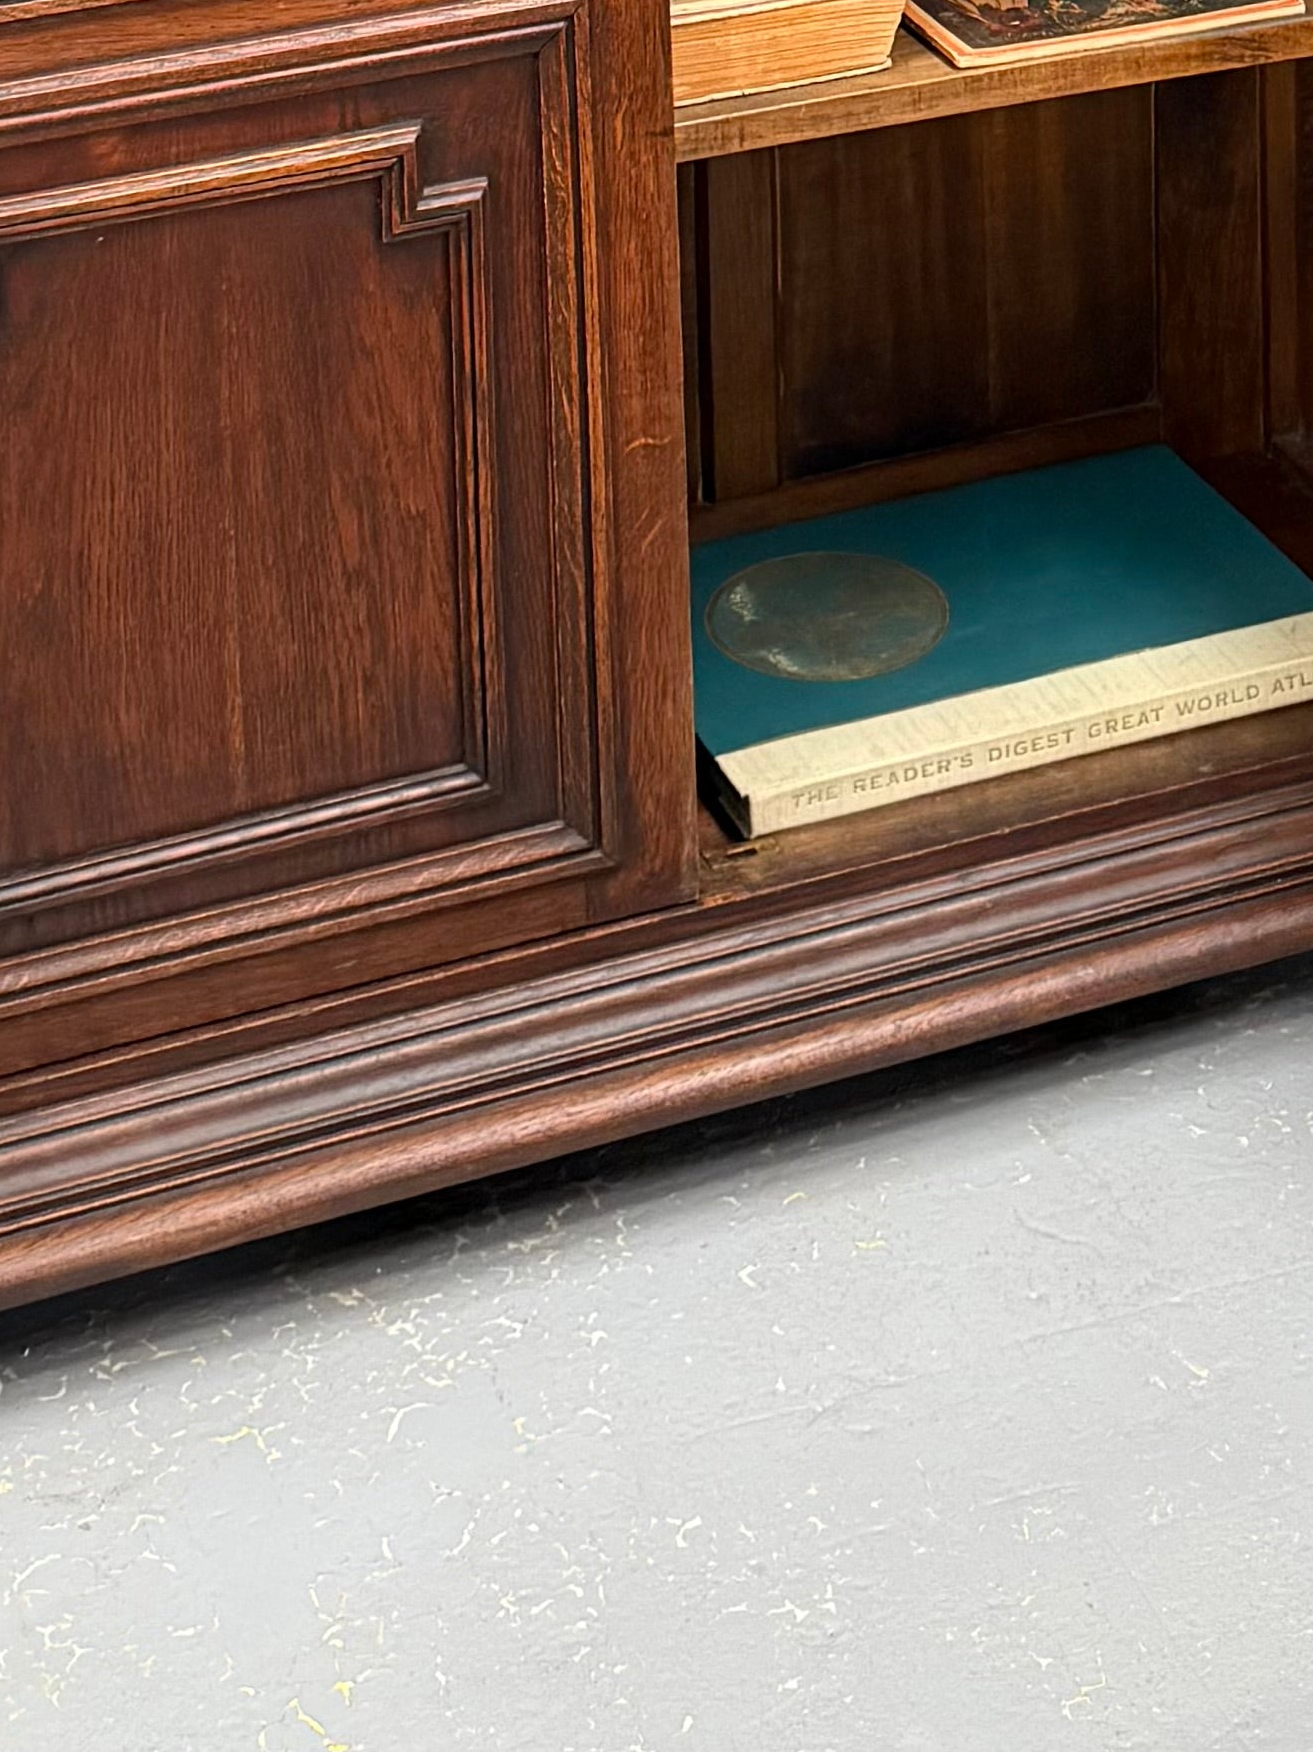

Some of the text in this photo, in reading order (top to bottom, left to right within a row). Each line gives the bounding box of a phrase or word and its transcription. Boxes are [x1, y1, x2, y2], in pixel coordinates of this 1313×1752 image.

[790, 789, 839, 809] THE
[852, 753, 975, 795] READER'S
[988, 728, 1076, 763] DIGEST
[1087, 706, 1164, 739] GREAT
[1176, 684, 1261, 717] WORLD
